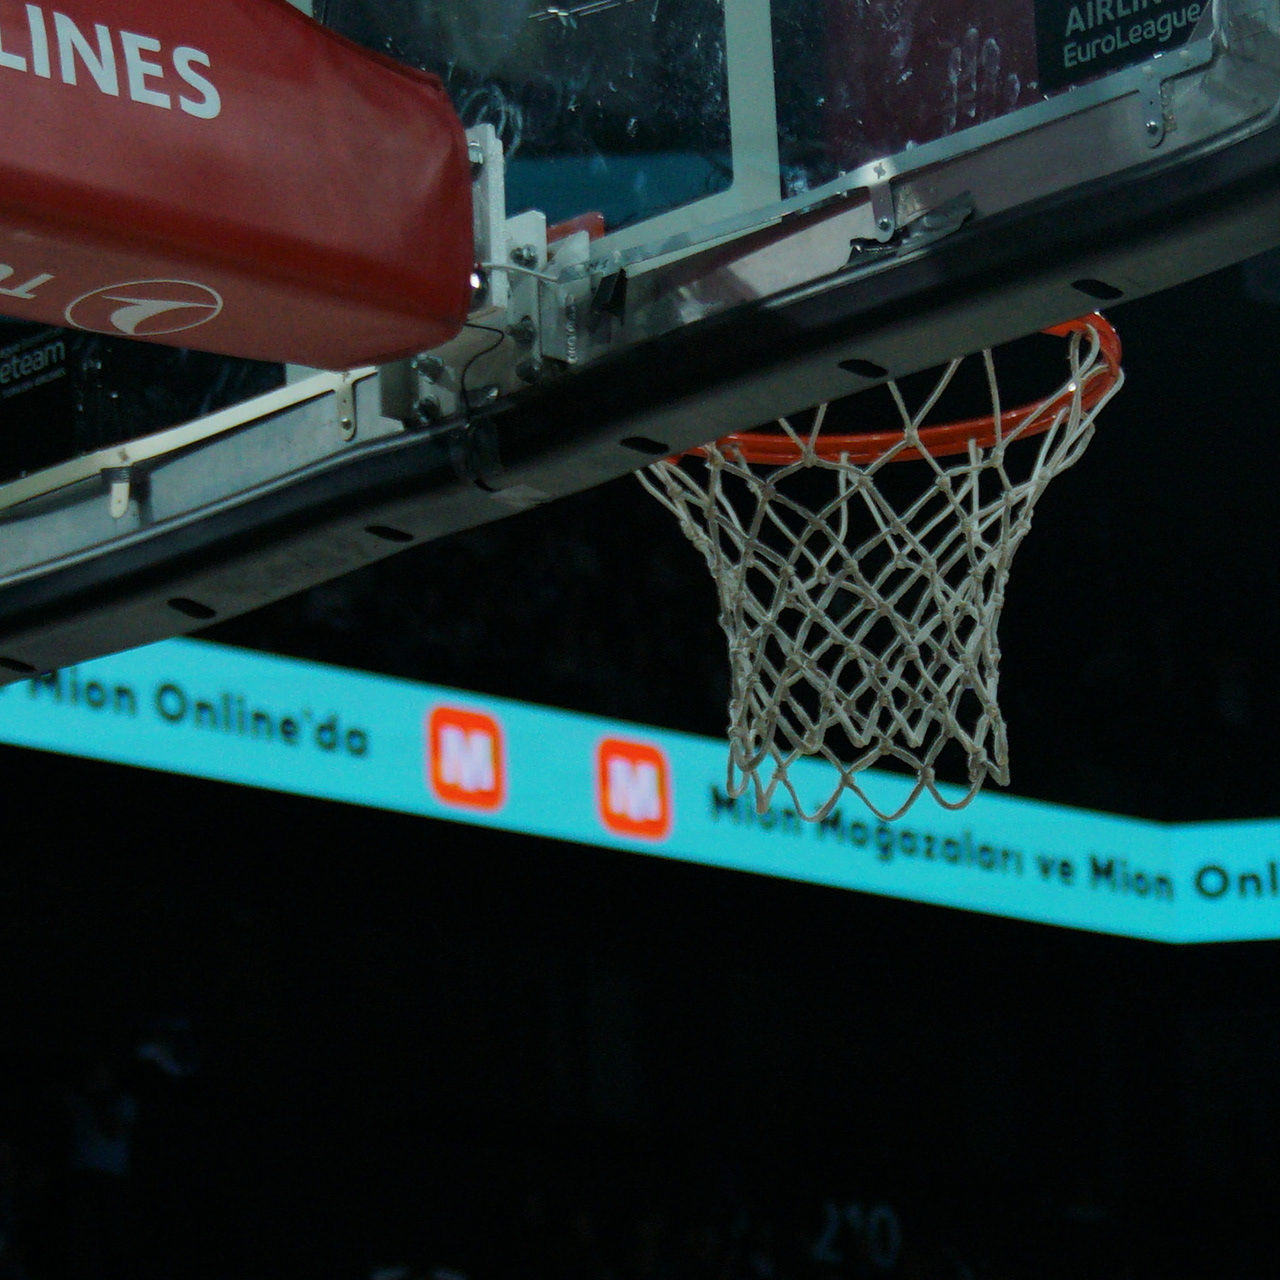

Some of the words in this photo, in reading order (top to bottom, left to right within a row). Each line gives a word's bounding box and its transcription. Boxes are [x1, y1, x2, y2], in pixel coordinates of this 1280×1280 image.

[1063, 3, 1201, 69] EuroLeague
[155, 683, 370, 759] Online'da
[1037, 854, 1075, 885] ve
[1089, 852, 1174, 901] Mion
